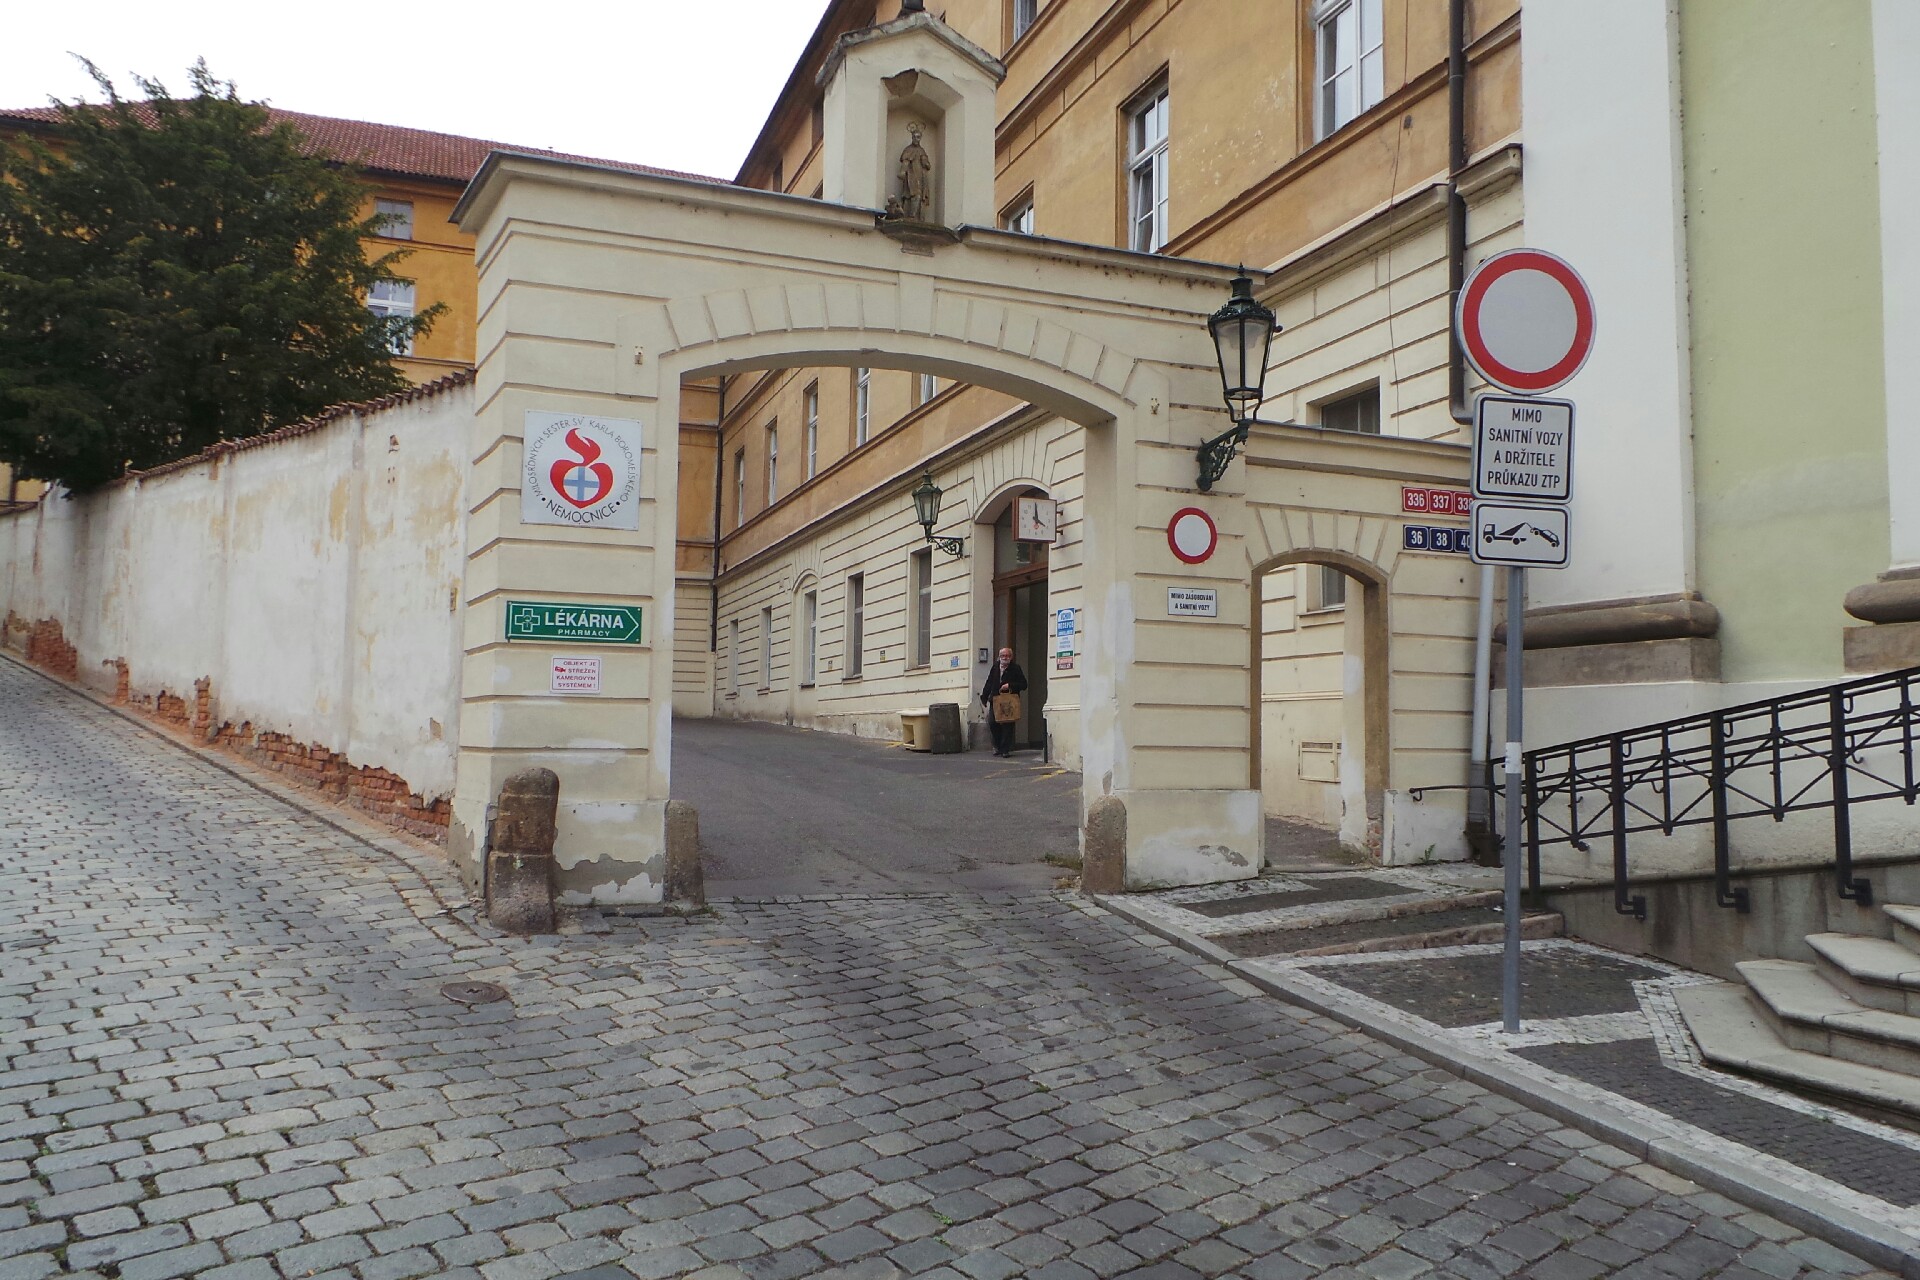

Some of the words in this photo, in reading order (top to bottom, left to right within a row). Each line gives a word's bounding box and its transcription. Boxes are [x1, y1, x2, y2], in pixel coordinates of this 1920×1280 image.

[1512, 408, 1542, 423] MIMO
[542, 419, 571, 439] SESTER
[589, 420, 614, 439] KARLA
[1488, 427, 1533, 444] SANITNÍ
[1536, 431, 1563, 446] VOZY
[1494, 450, 1501, 464] A
[1505, 448, 1556, 467] DRŽITELE
[1487, 469, 1538, 487] PRŮKAZU
[1541, 474, 1560, 489] ZTP
[1407, 492, 1425, 507] 336
[1432, 494, 1449, 509] 337
[546, 499, 617, 523] NEMOCNICE
[1411, 530, 1423, 545] 36
[1436, 532, 1448, 547] 38
[1170, 592, 1184, 600] MIMO
[544, 608, 624, 629] LÉKÁRNA
[558, 628, 610, 637] PHARMACY
